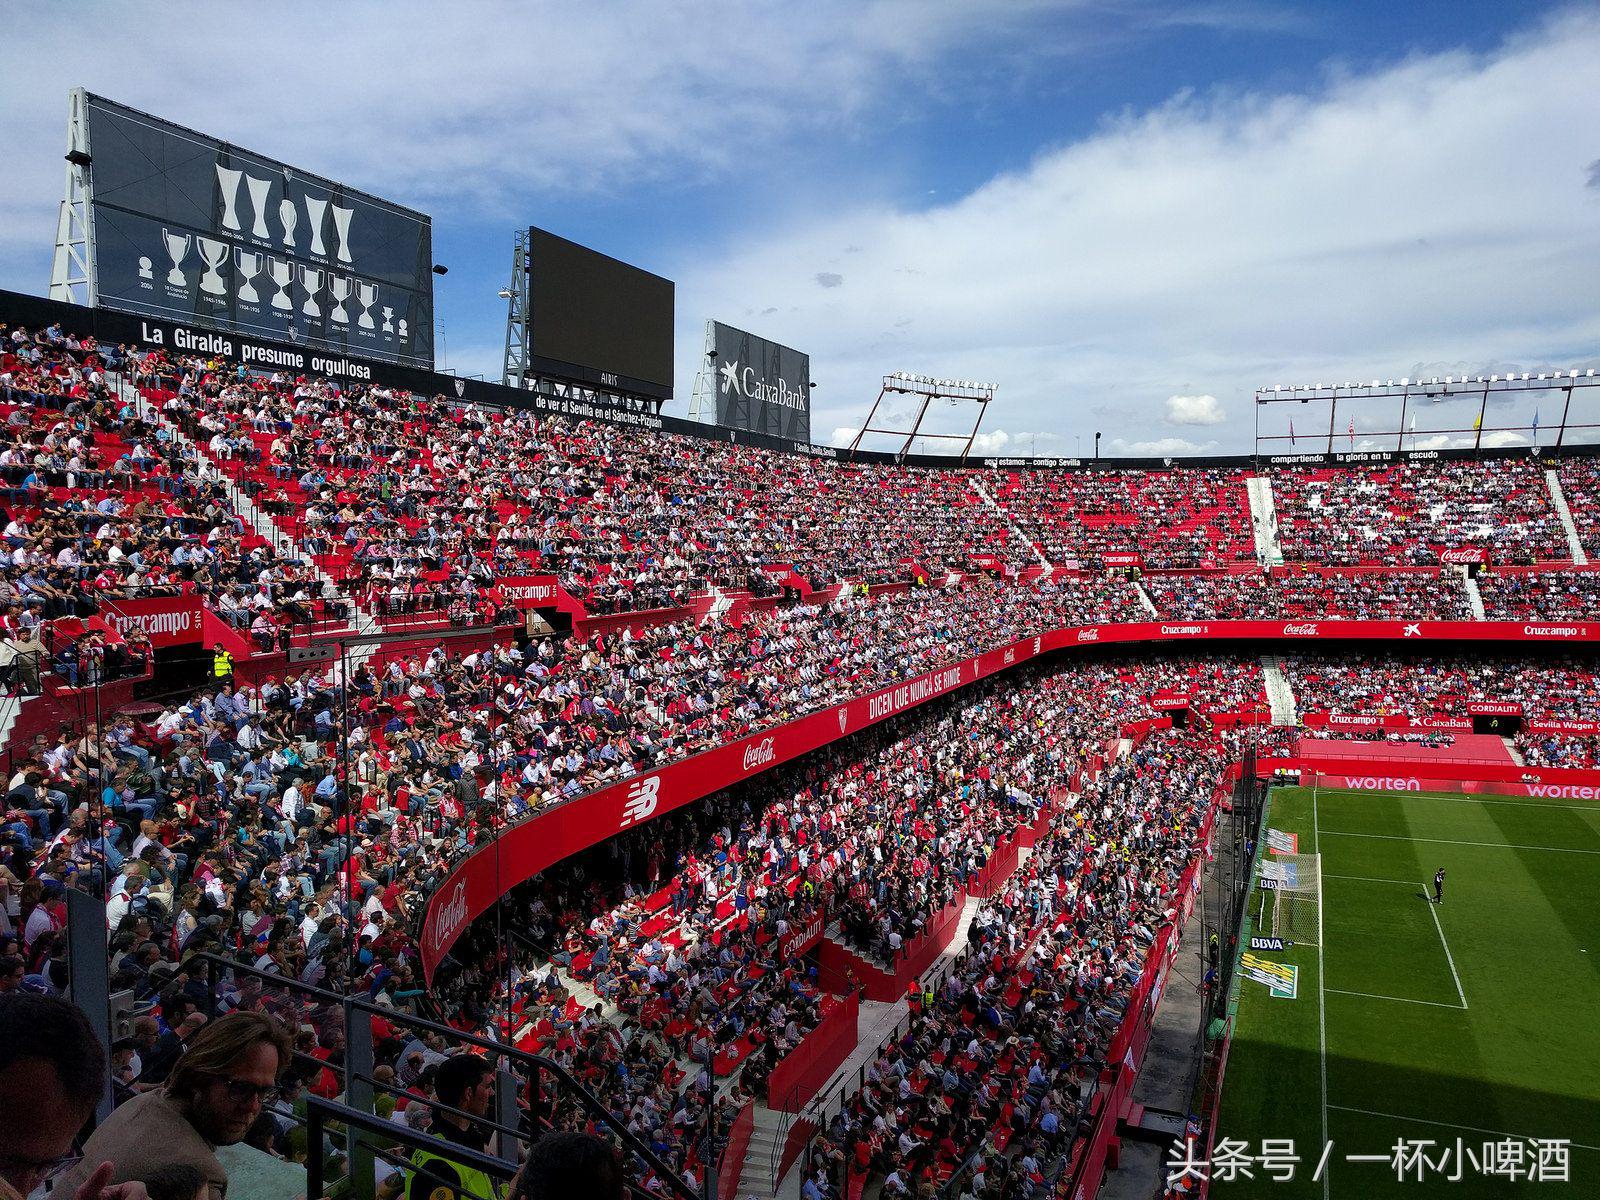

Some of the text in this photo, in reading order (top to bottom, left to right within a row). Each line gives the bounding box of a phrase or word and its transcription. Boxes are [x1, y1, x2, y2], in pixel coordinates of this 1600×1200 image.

[140, 281, 153, 290] 2006
[142, 322, 371, 380] La Giralda presume orgullosa
[600, 372, 618, 386] AIRIS
[743, 366, 806, 411] CaixaBank
[536, 395, 663, 429] de ver al Sevilla en el Sánchez-Pizjuán
[1270, 453, 1324, 464] compartiendo
[1336, 453, 1344, 461] la
[1345, 452, 1369, 462] gloria
[1383, 452, 1391, 460] tu
[1408, 450, 1438, 459] escudo
[999, 458, 1026, 466] estamos
[1032, 458, 1057, 467] contigo
[1058, 458, 1081, 466] Sevilla
[498, 584, 550, 601] Cruzcampo
[105, 611, 190, 636] Cruzcampo
[1161, 625, 1201, 636] Cruzcampo
[1524, 625, 1578, 637] Cruzcampo
[869, 667, 961, 720] DICEN QUE NUNCA SE RINDE
[1153, 698, 1188, 706] CORDIALITY
[1470, 705, 1518, 713] CORDIALITY
[1329, 714, 1376, 726] Cruzcampo
[1423, 717, 1473, 728] CaixaBank
[1533, 720, 1560, 728] Sevilla
[1562, 721, 1594, 730] Wagen
[1345, 776, 1420, 791] worten
[1251, 937, 1283, 949] BBVA
